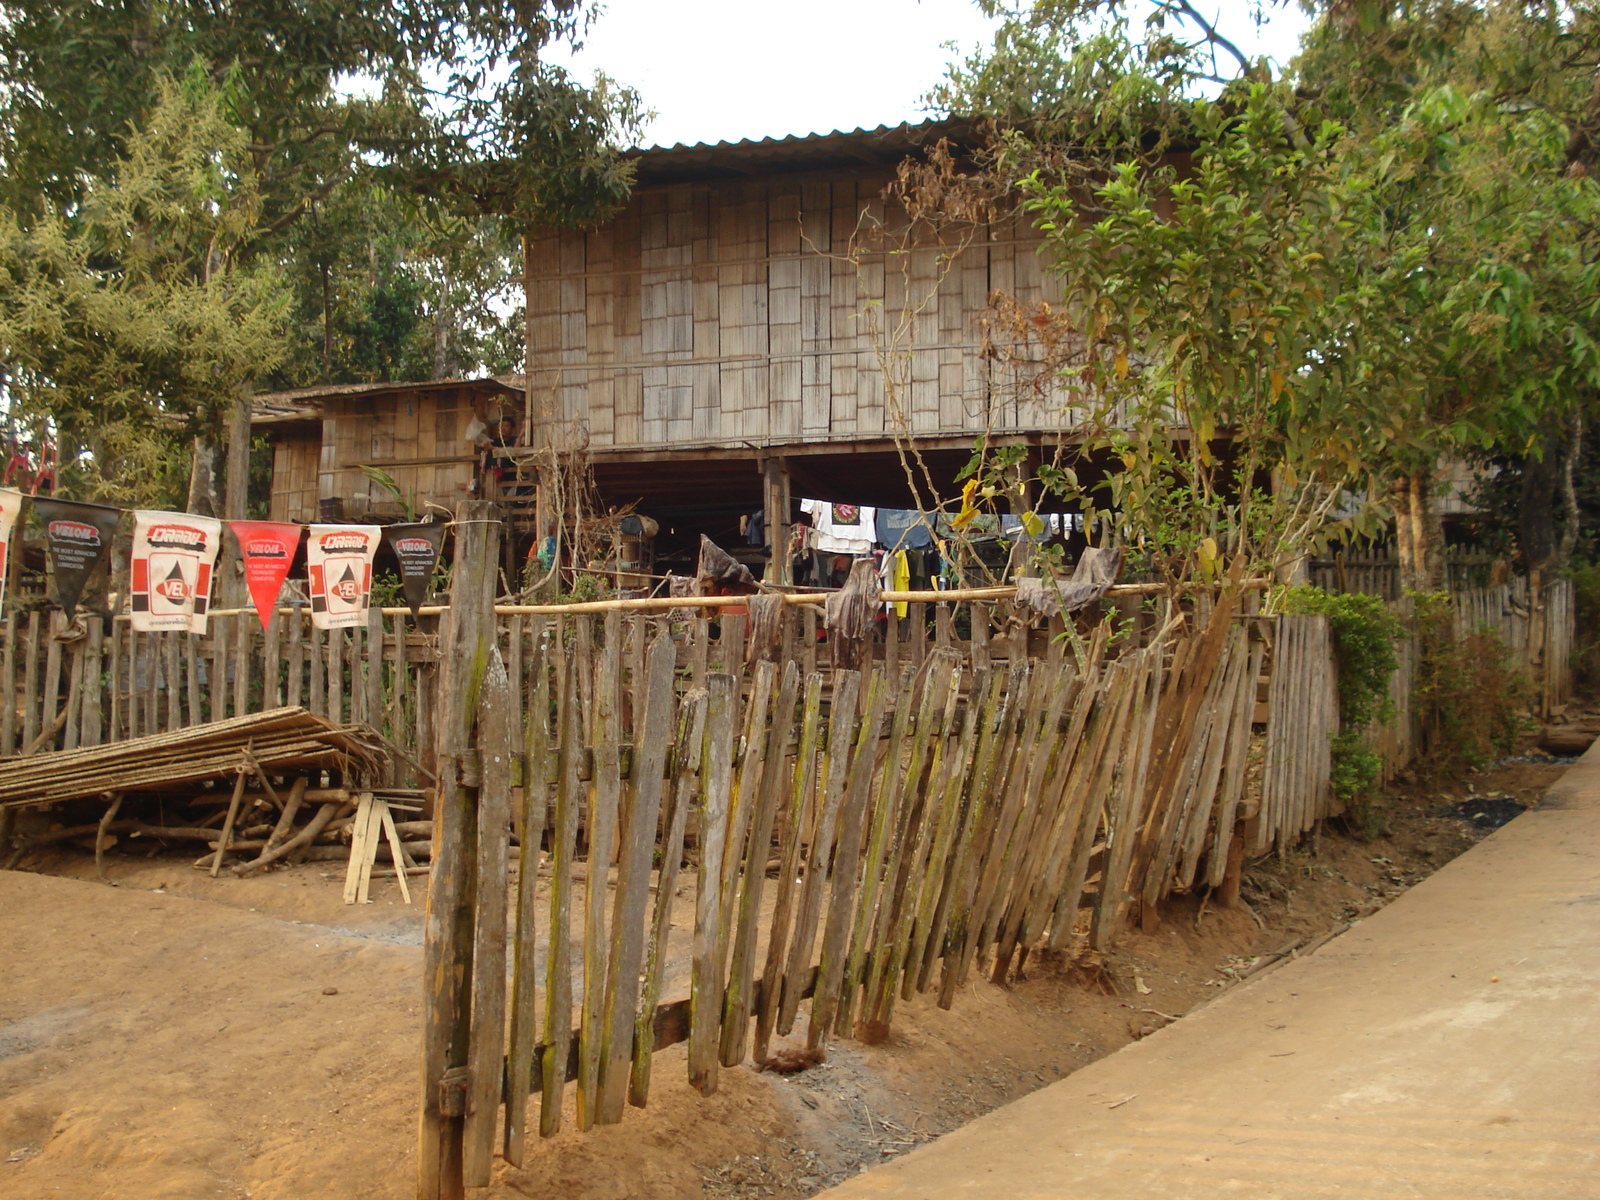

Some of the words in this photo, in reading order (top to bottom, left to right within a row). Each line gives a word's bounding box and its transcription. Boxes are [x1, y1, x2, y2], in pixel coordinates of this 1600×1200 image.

[55, 525, 91, 540] VELOIL
[250, 543, 280, 554] VELOIL
[401, 542, 427, 552] VELOIL
[58, 554, 85, 562] TECHNOLOGY
